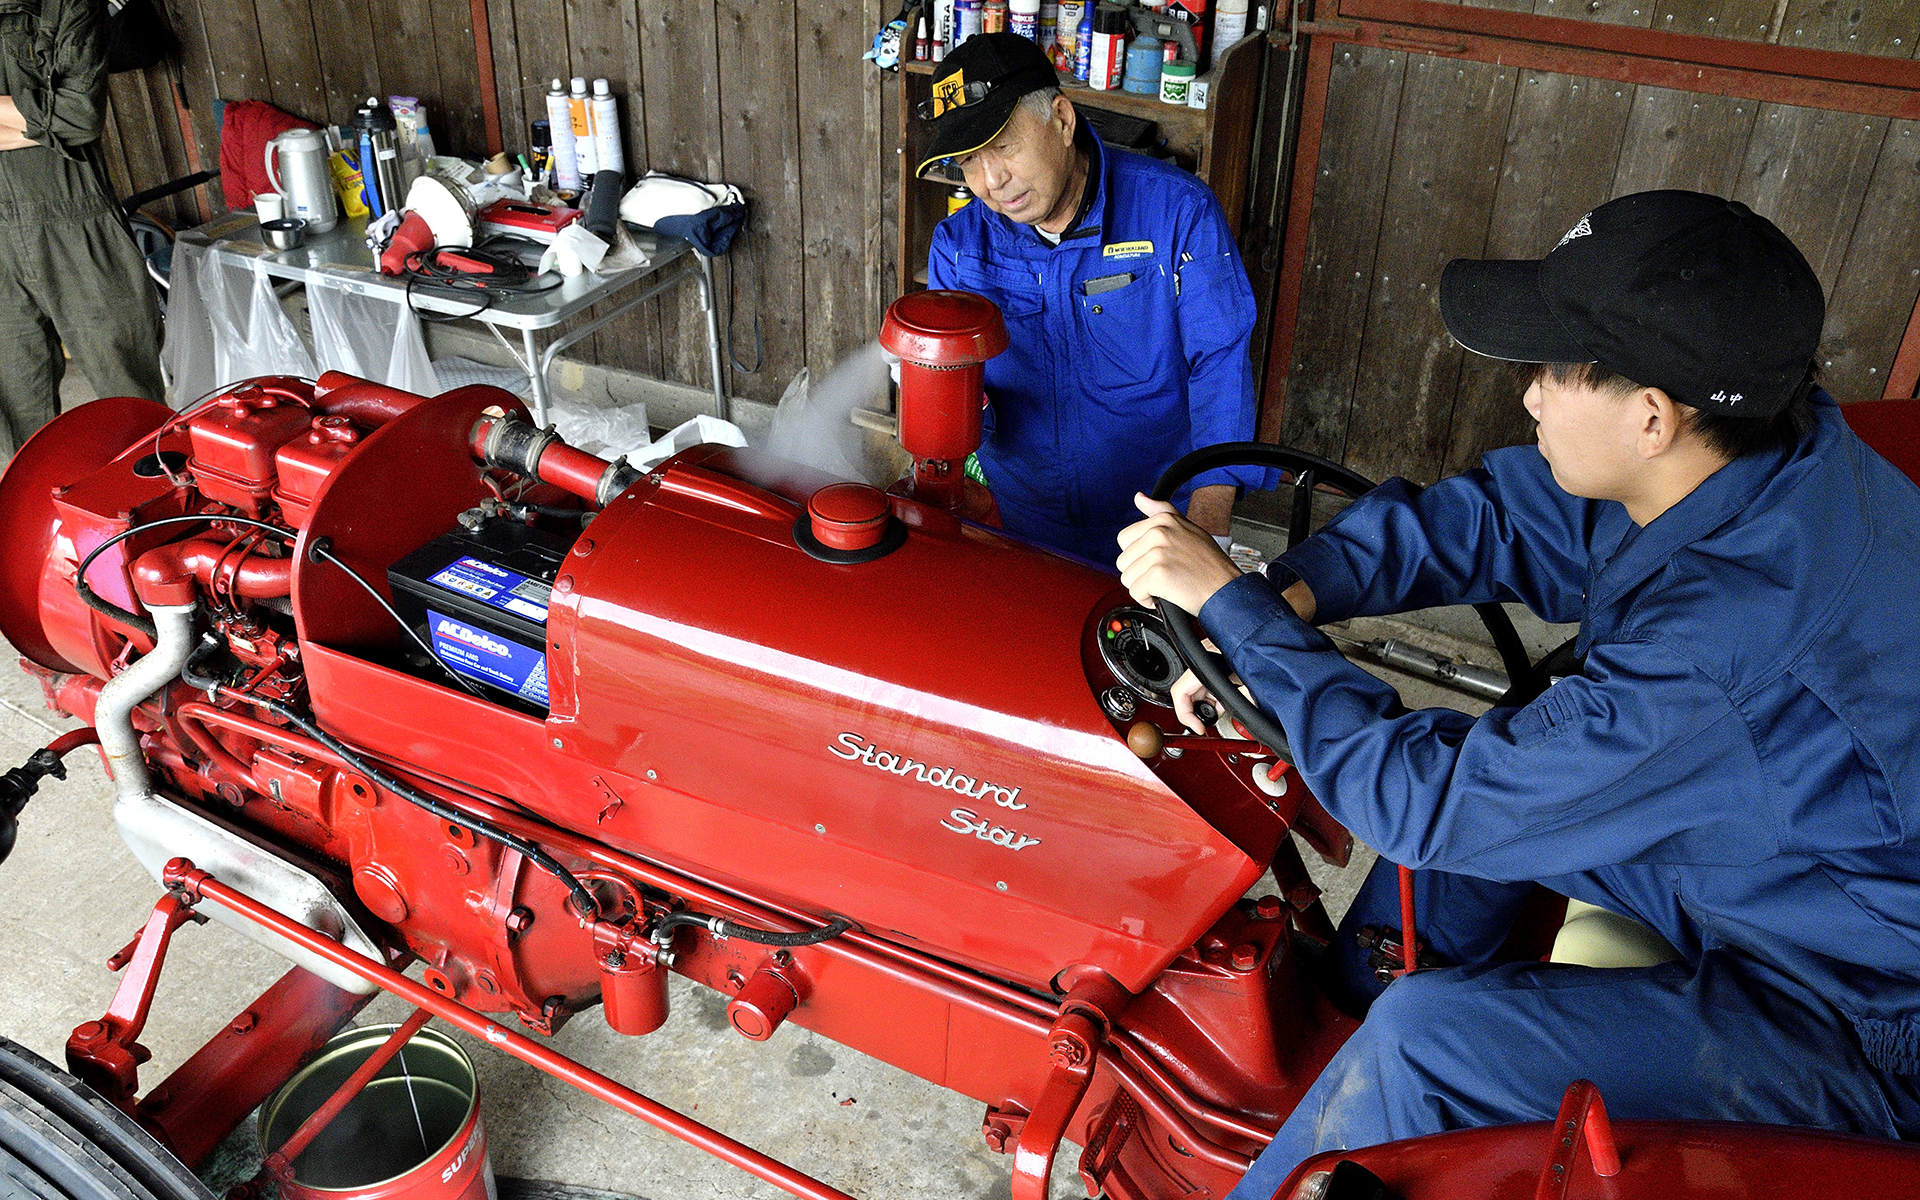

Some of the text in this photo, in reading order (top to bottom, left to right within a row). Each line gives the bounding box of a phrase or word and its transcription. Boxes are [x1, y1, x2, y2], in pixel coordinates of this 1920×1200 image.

[943, 4, 951, 44] ULTRA
[1710, 390, 1743, 406] 山中
[461, 559, 509, 577] ACDelco
[437, 620, 509, 656] ACDelco
[439, 641, 479, 662] PREMIUM AMS
[827, 731, 1028, 811] Standard
[940, 807, 1042, 851] Star
